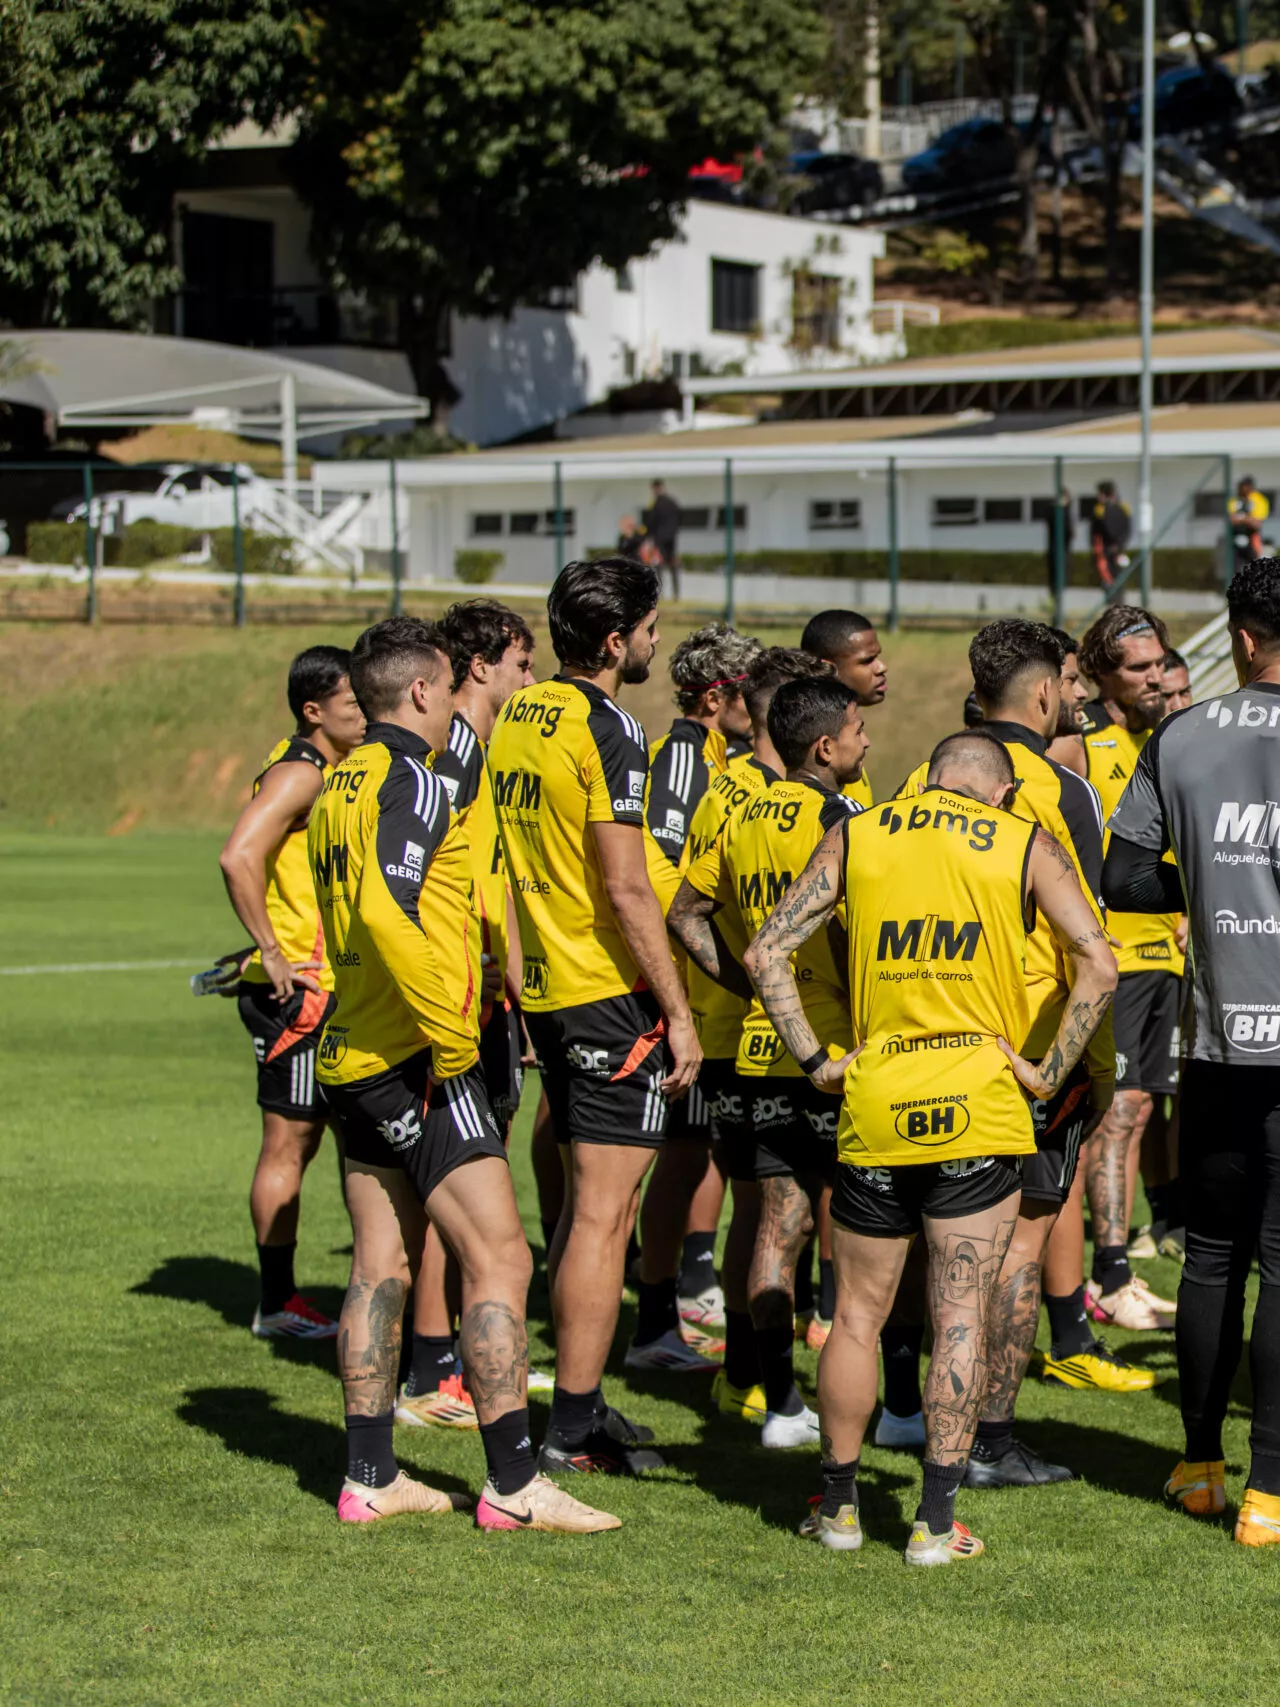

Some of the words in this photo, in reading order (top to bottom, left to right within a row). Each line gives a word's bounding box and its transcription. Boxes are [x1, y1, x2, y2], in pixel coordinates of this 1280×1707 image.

[541, 690, 571, 703] banco
[513, 695, 565, 738] bmg
[746, 796, 803, 833] bmg
[939, 795, 983, 815] banco
[907, 804, 999, 851] bmg
[1213, 851, 1255, 865] Aluguel
[1255, 853, 1270, 865] de
[386, 863, 422, 883] GERD
[876, 914, 984, 962] MM
[878, 969, 919, 983] Aluguel
[921, 970, 935, 980] de
[936, 971, 973, 982] carros
[1231, 1014, 1280, 1042] BH
[748, 1034, 779, 1057] BH
[881, 1032, 983, 1055] mundiale
[890, 1094, 968, 1111] SUPERMERCADOS
[908, 1107, 955, 1138] BH
